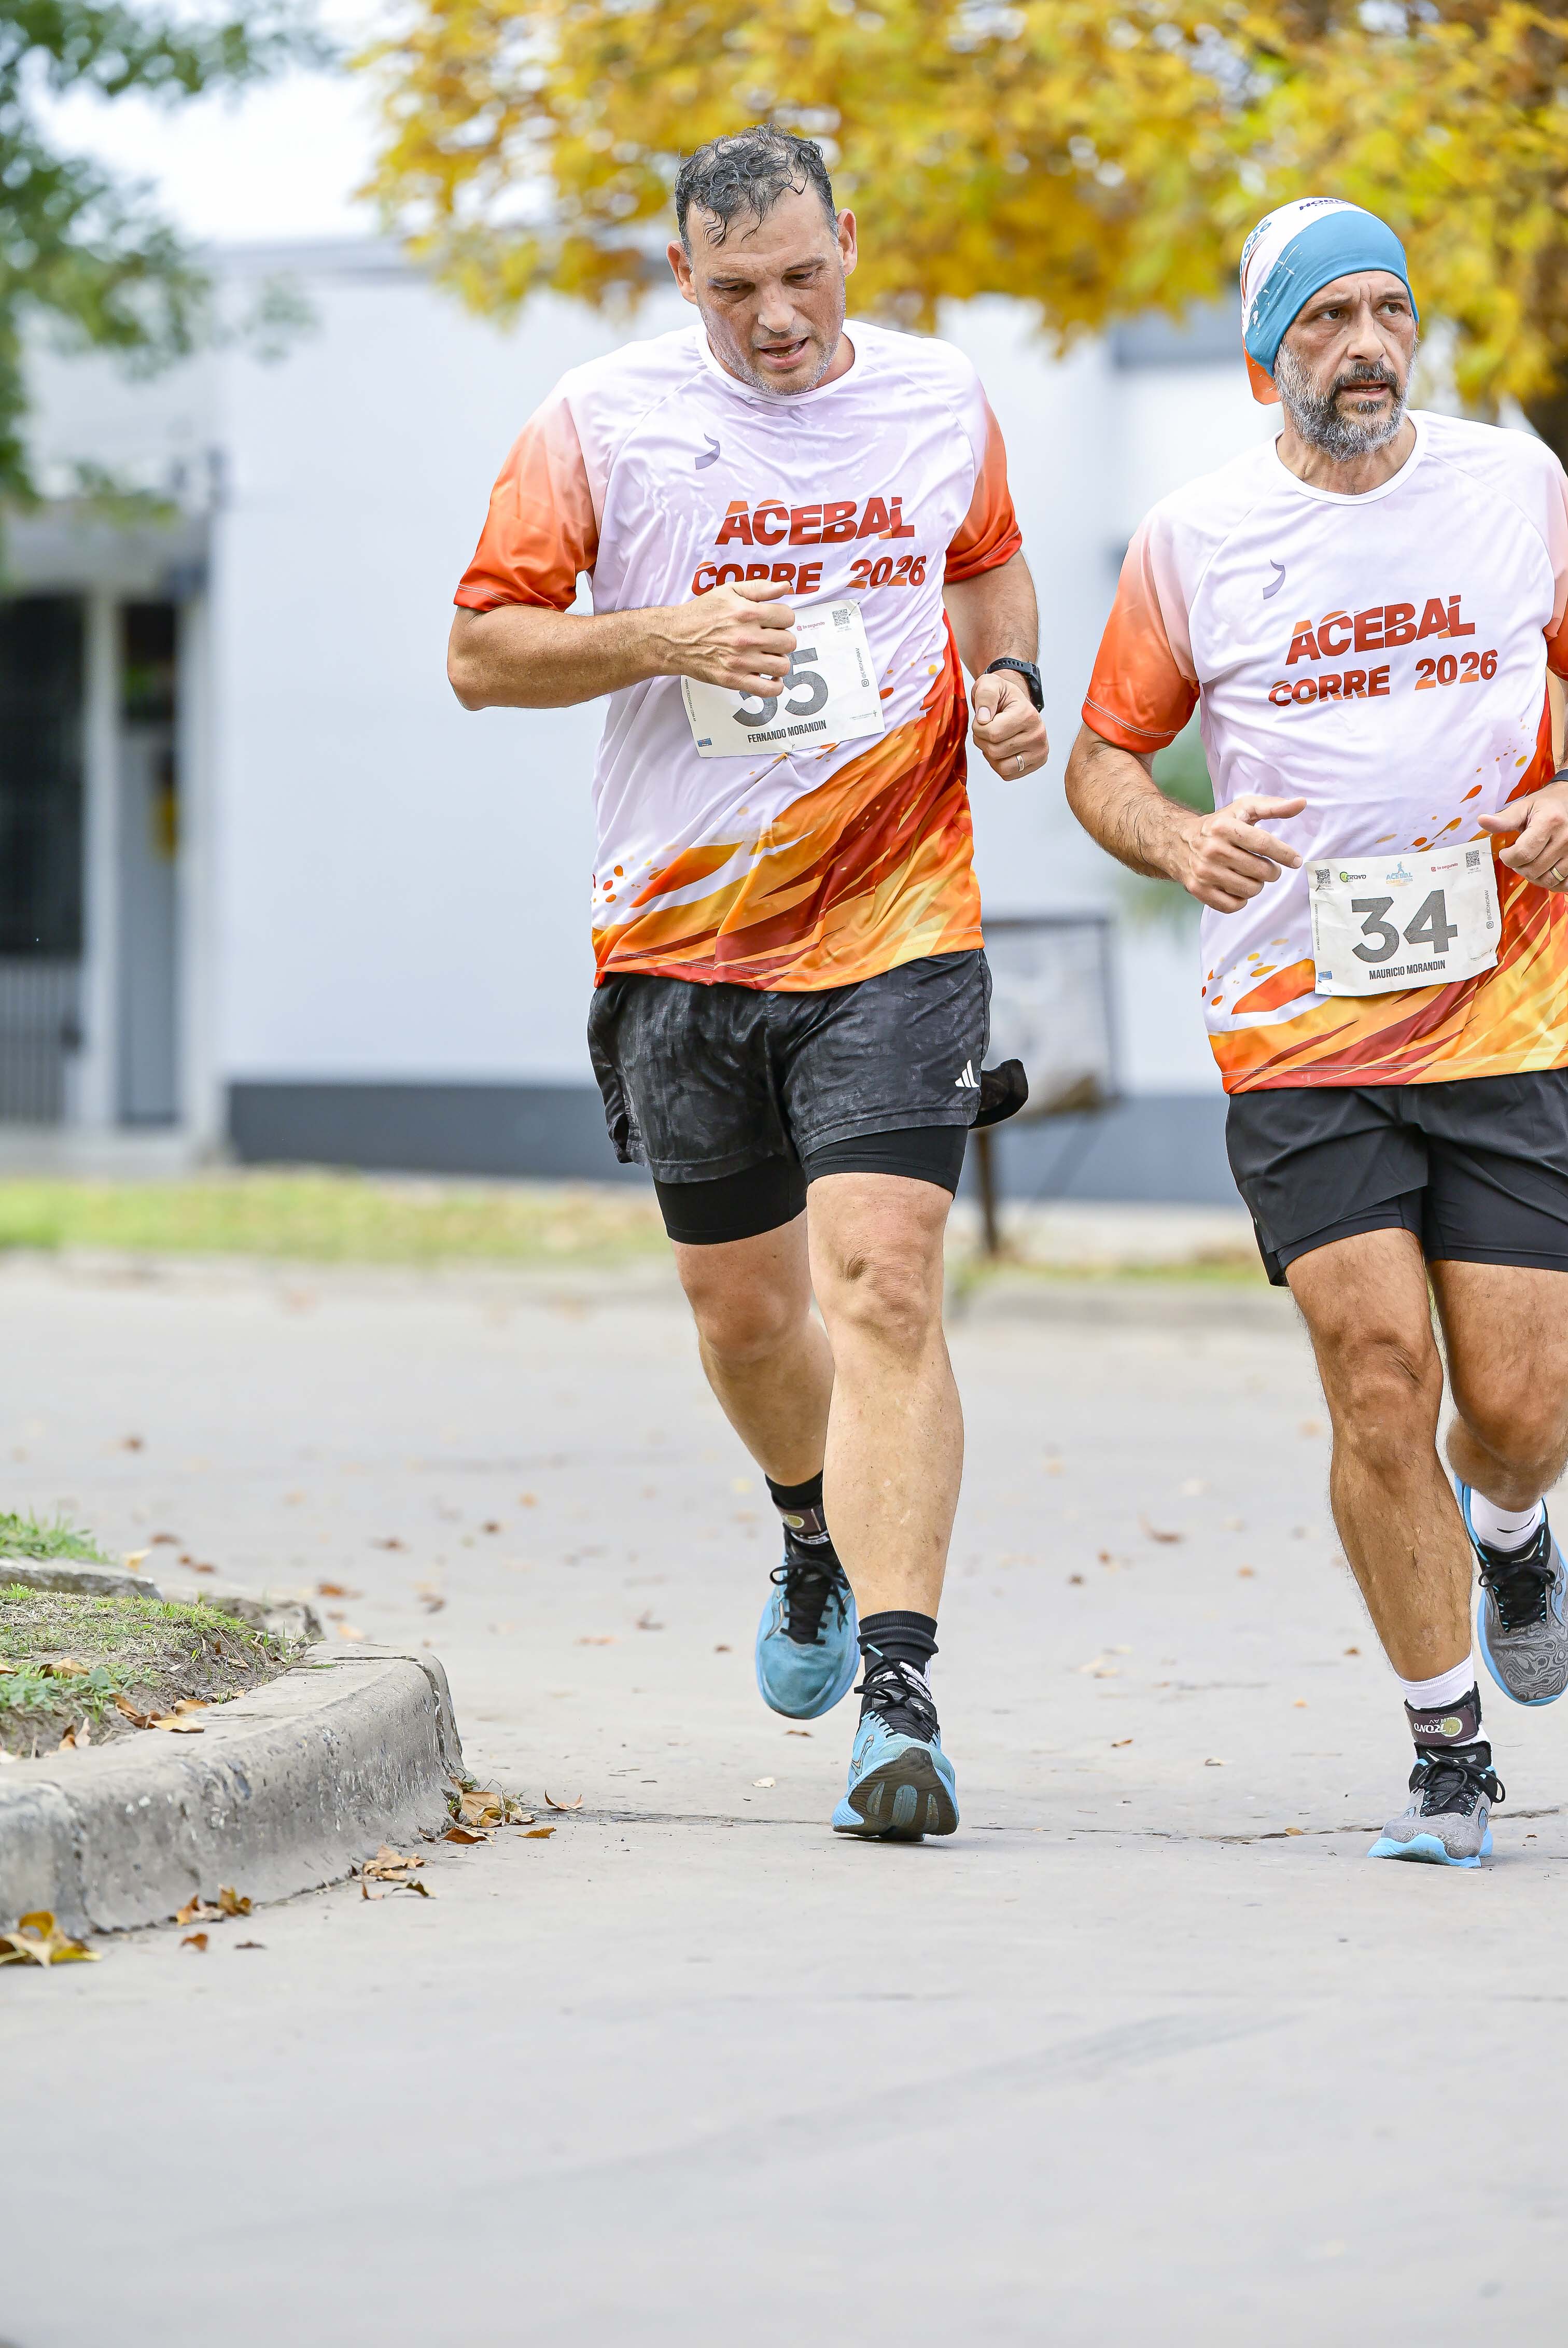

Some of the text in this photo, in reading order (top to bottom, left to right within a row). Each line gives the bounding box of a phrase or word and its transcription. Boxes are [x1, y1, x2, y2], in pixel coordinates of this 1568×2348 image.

[715, 497, 915, 546] ACEBAL
[846, 555, 927, 590] 2026
[1285, 595, 1475, 665] ACEBAL
[1268, 649, 1498, 707] CORRE 2026
[747, 720, 827, 743] FERNANDO MORANDIN
[1351, 889, 1458, 963] 34
[1369, 959, 1446, 980] MAURICIO MORANDIN
